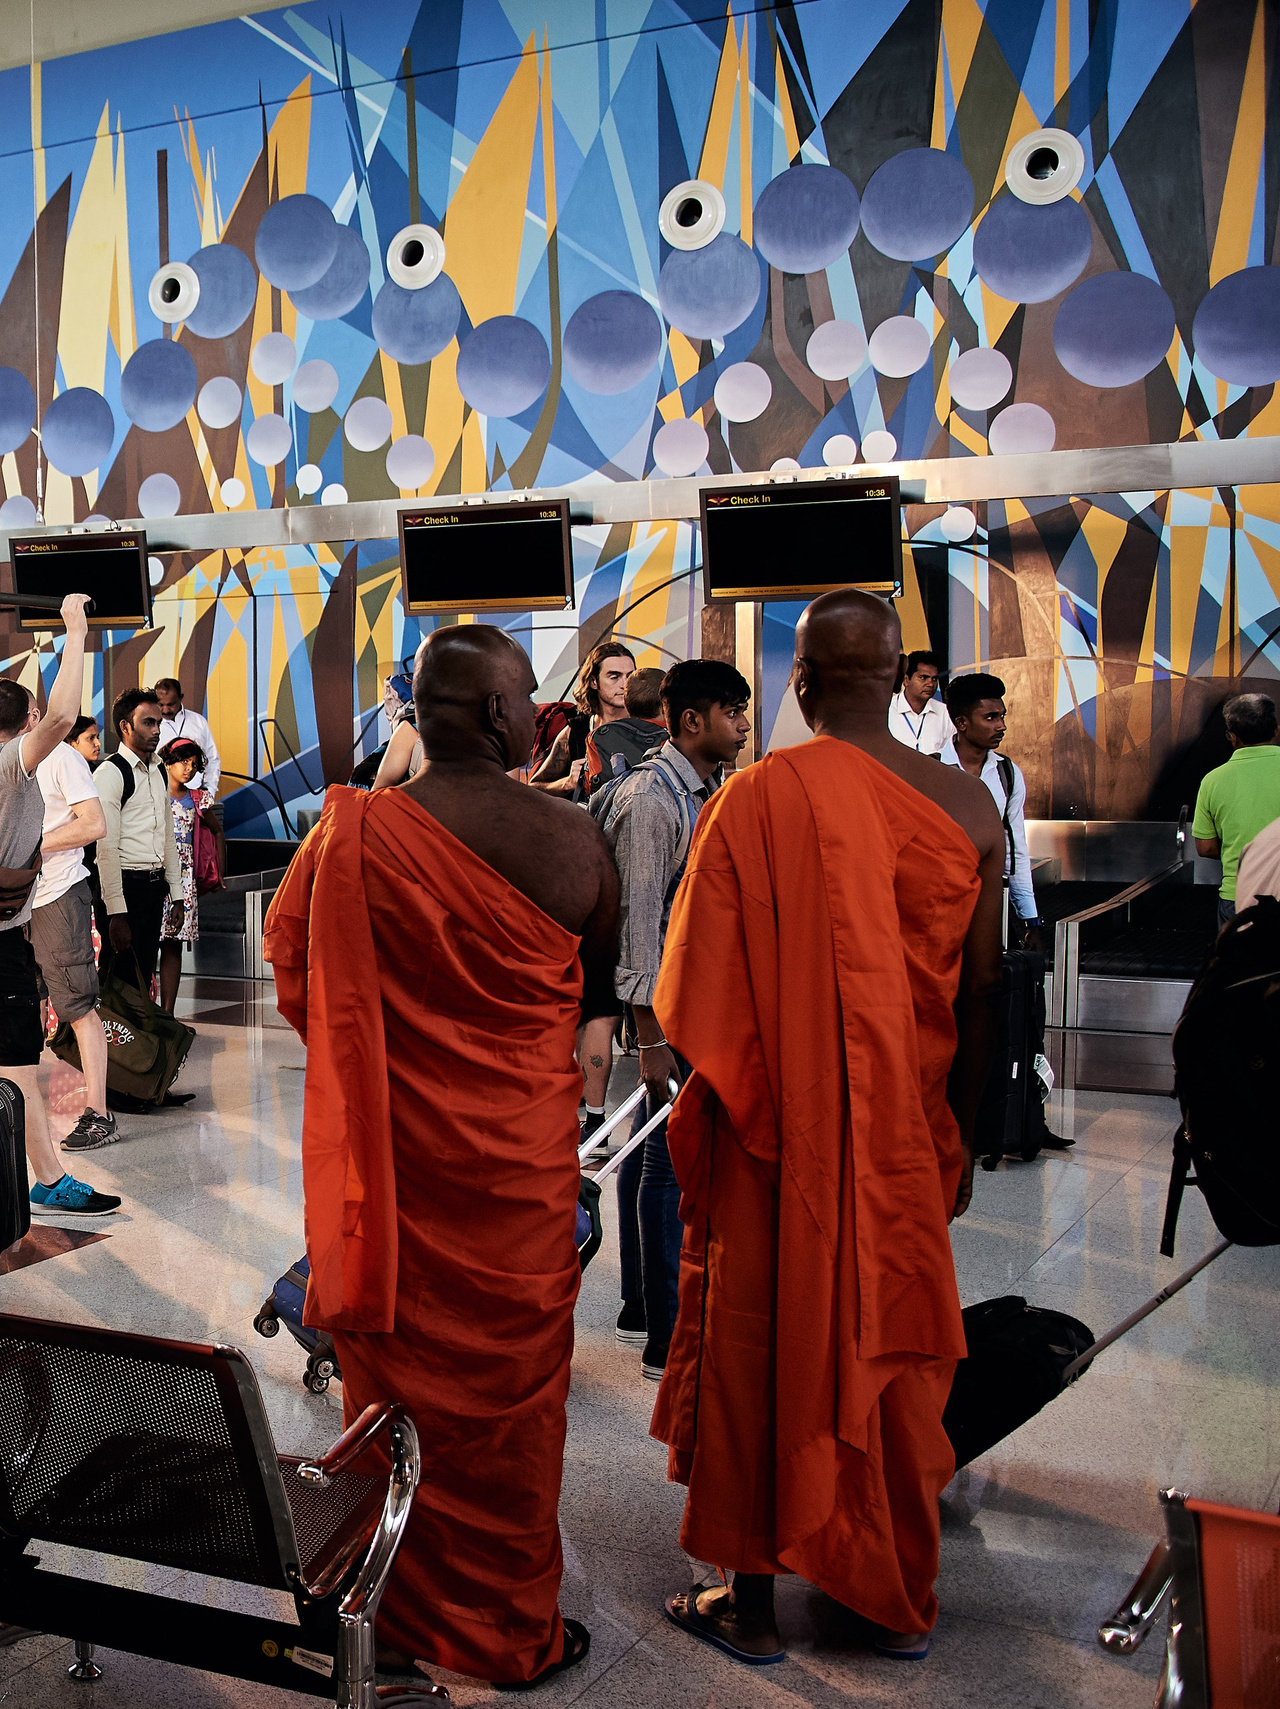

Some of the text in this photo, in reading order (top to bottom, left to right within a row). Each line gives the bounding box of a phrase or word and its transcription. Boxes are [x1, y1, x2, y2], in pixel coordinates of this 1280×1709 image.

[865, 489, 885, 497] 10:38
[730, 495, 771, 505] Check In
[424, 516, 450, 525] Check
[30, 544, 50, 552] Check
[102, 1020, 135, 1043] OLYMPIC
